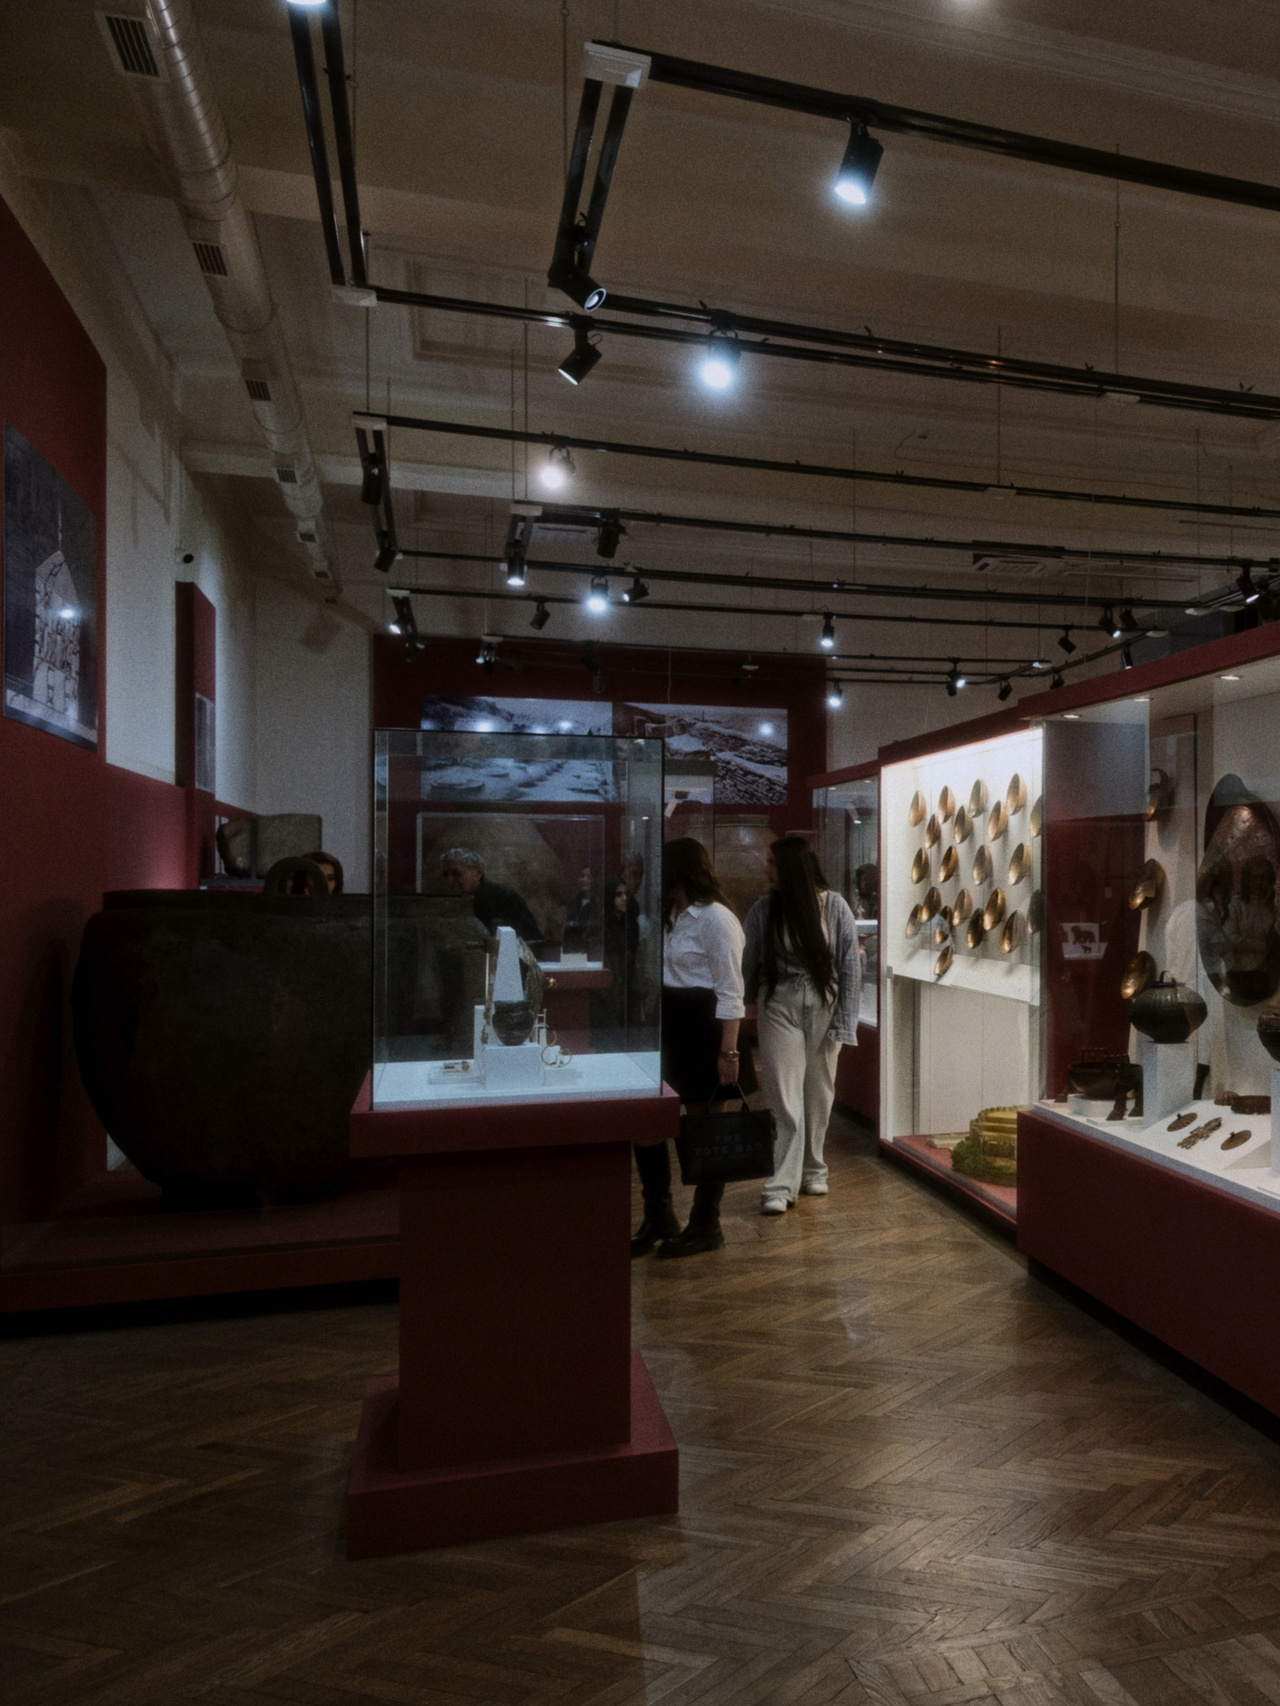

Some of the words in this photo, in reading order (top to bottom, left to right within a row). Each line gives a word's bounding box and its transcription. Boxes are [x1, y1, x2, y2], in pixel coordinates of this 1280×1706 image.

[714, 1134, 743, 1144] THE
[694, 1145, 729, 1157] TOTE
[735, 1143, 763, 1154] BAG
